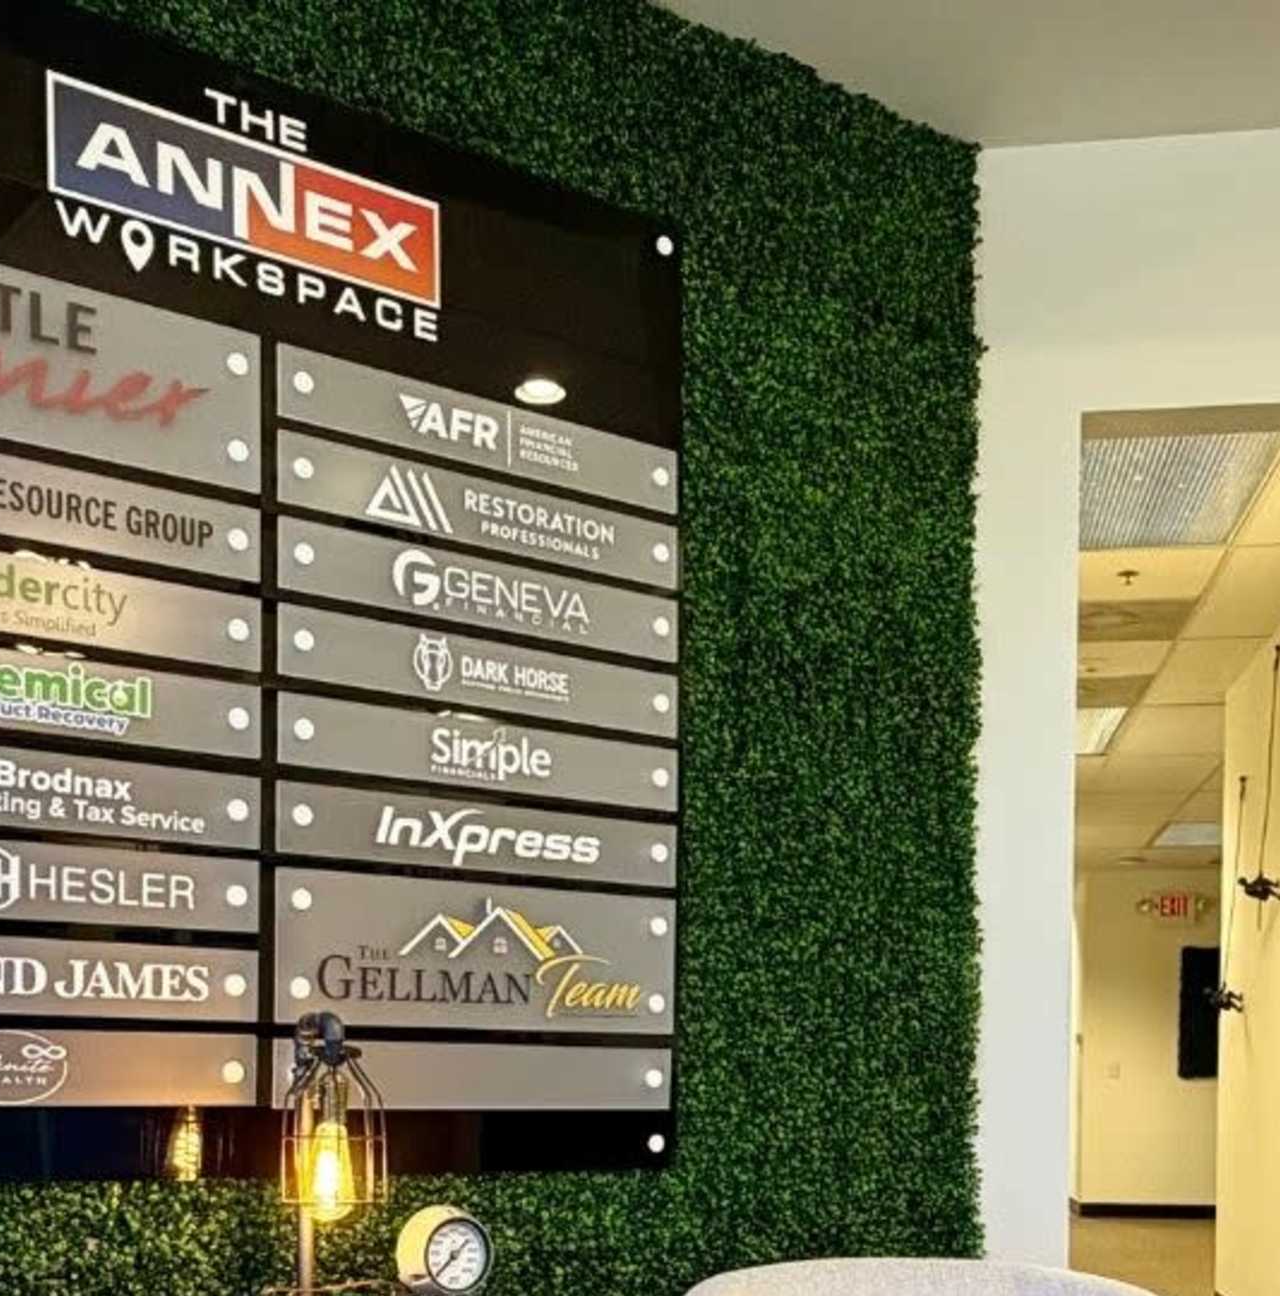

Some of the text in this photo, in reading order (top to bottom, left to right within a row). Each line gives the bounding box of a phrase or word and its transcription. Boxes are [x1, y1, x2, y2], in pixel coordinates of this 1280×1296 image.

[205, 88, 307, 152] THE
[75, 122, 420, 273] ANNEX
[55, 199, 438, 342] WORKSPACE
[417, 402, 500, 451] AFR
[125, 506, 214, 548] GROUP
[463, 487, 615, 545] RESTORATION
[480, 520, 600, 560] PROFESSIONALS
[443, 566, 589, 625] GENEVA
[445, 597, 588, 634] FINANCIAL
[13, 609, 97, 637] Simplified
[461, 656, 509, 684] DARK
[514, 666, 570, 694] HORSE
[37, 703, 129, 735] Recovery
[431, 728, 552, 781] Simple
[48, 800, 67, 819] &
[73, 799, 115, 824] Tax
[120, 806, 207, 835] Service
[376, 806, 601, 866] InXpress
[28, 864, 196, 910] HESLER
[1160, 896, 1188, 917] EXIT
[53, 959, 211, 1002] JAMES
[317, 953, 641, 1018] GELLMAN Team
